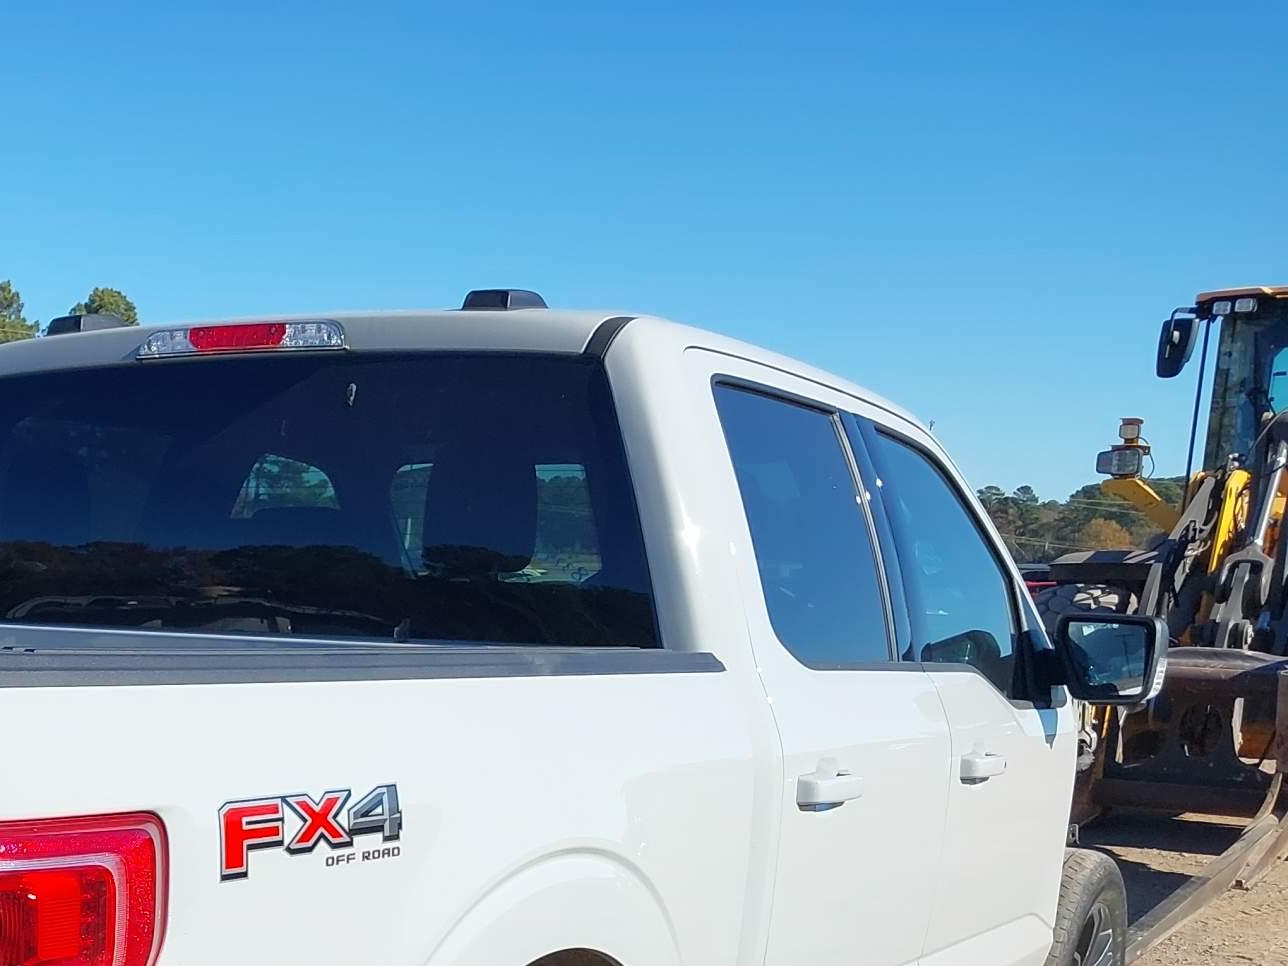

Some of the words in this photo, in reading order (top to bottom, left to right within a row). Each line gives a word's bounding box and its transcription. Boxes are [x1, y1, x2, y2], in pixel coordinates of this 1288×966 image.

[218, 784, 402, 881] FX4
[325, 852, 356, 867] OFF
[362, 846, 401, 862] ROAD
